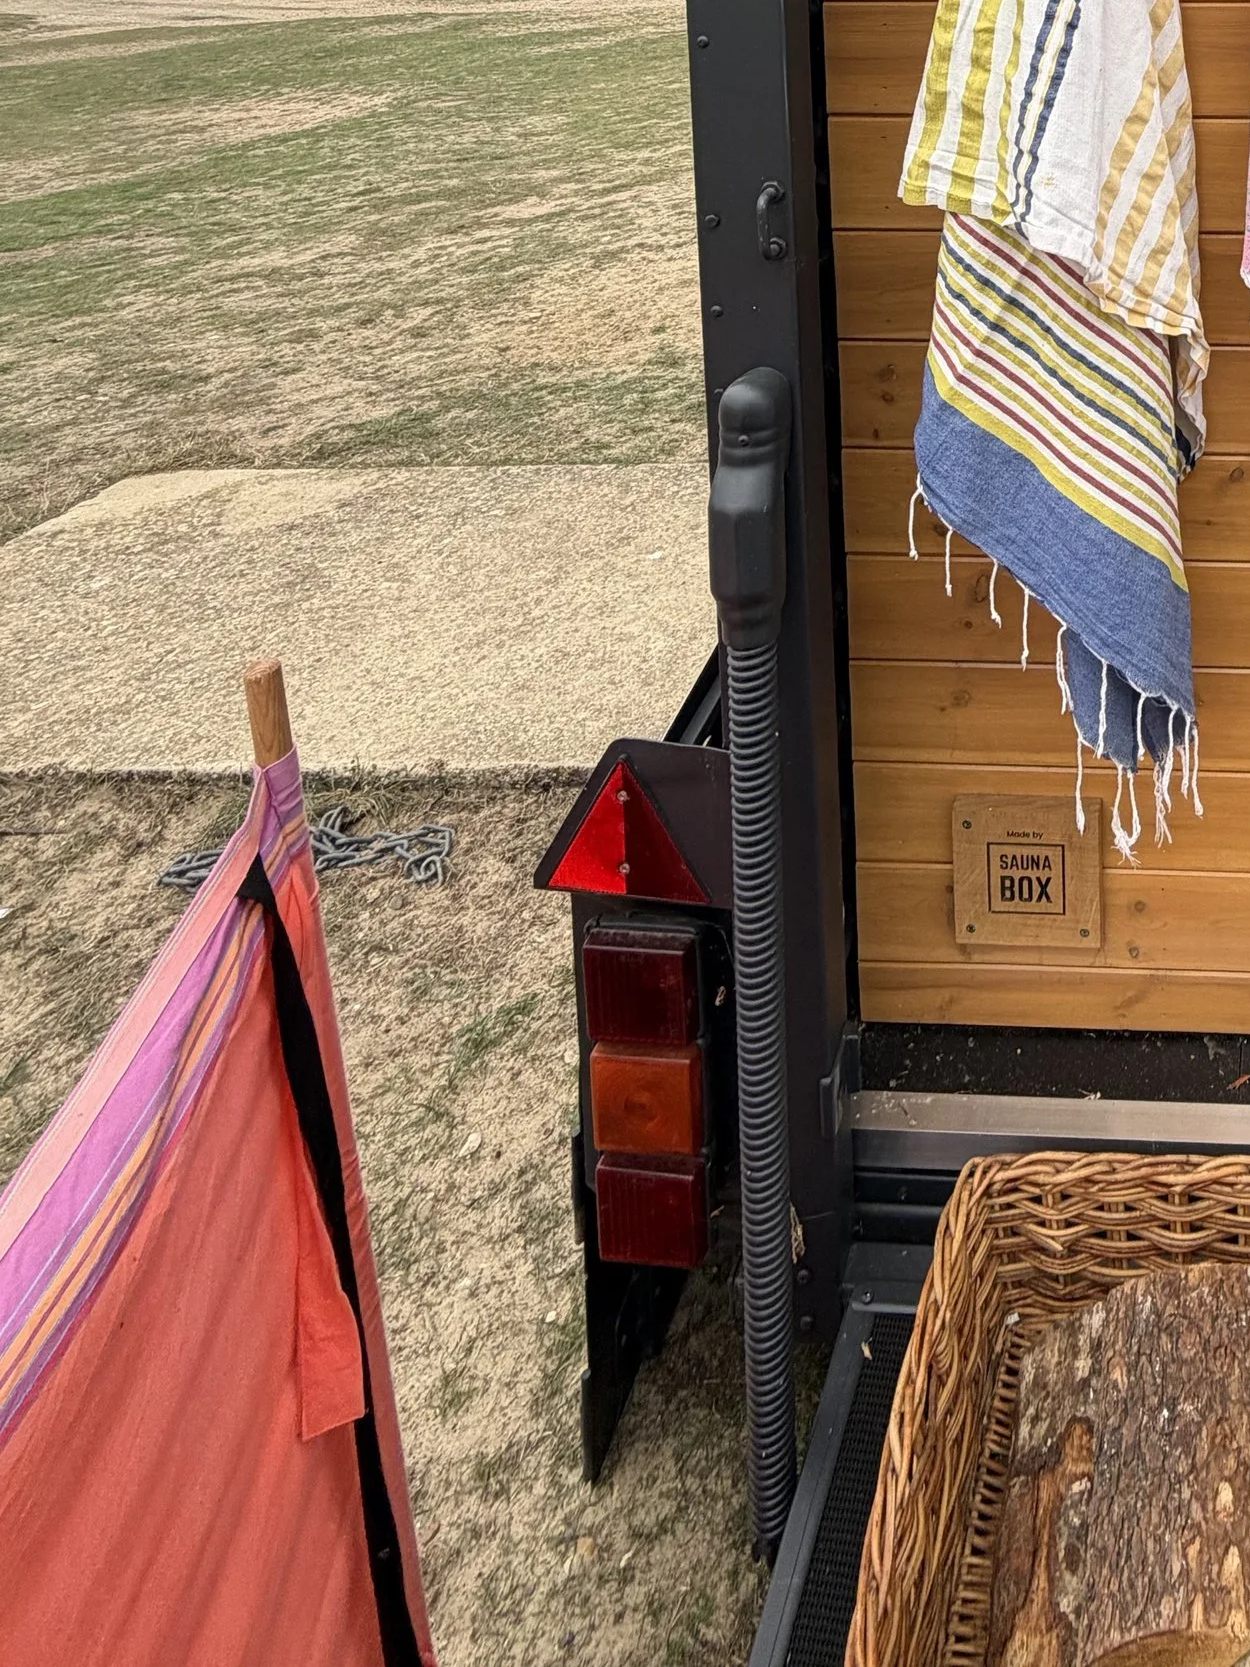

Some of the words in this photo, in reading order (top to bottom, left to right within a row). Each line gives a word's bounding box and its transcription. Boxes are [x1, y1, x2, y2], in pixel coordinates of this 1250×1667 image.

[1006, 830, 1030, 838] Made
[1032, 830, 1043, 840] by
[1000, 854, 1052, 871] SAUNA
[1000, 875, 1053, 903] BOX
